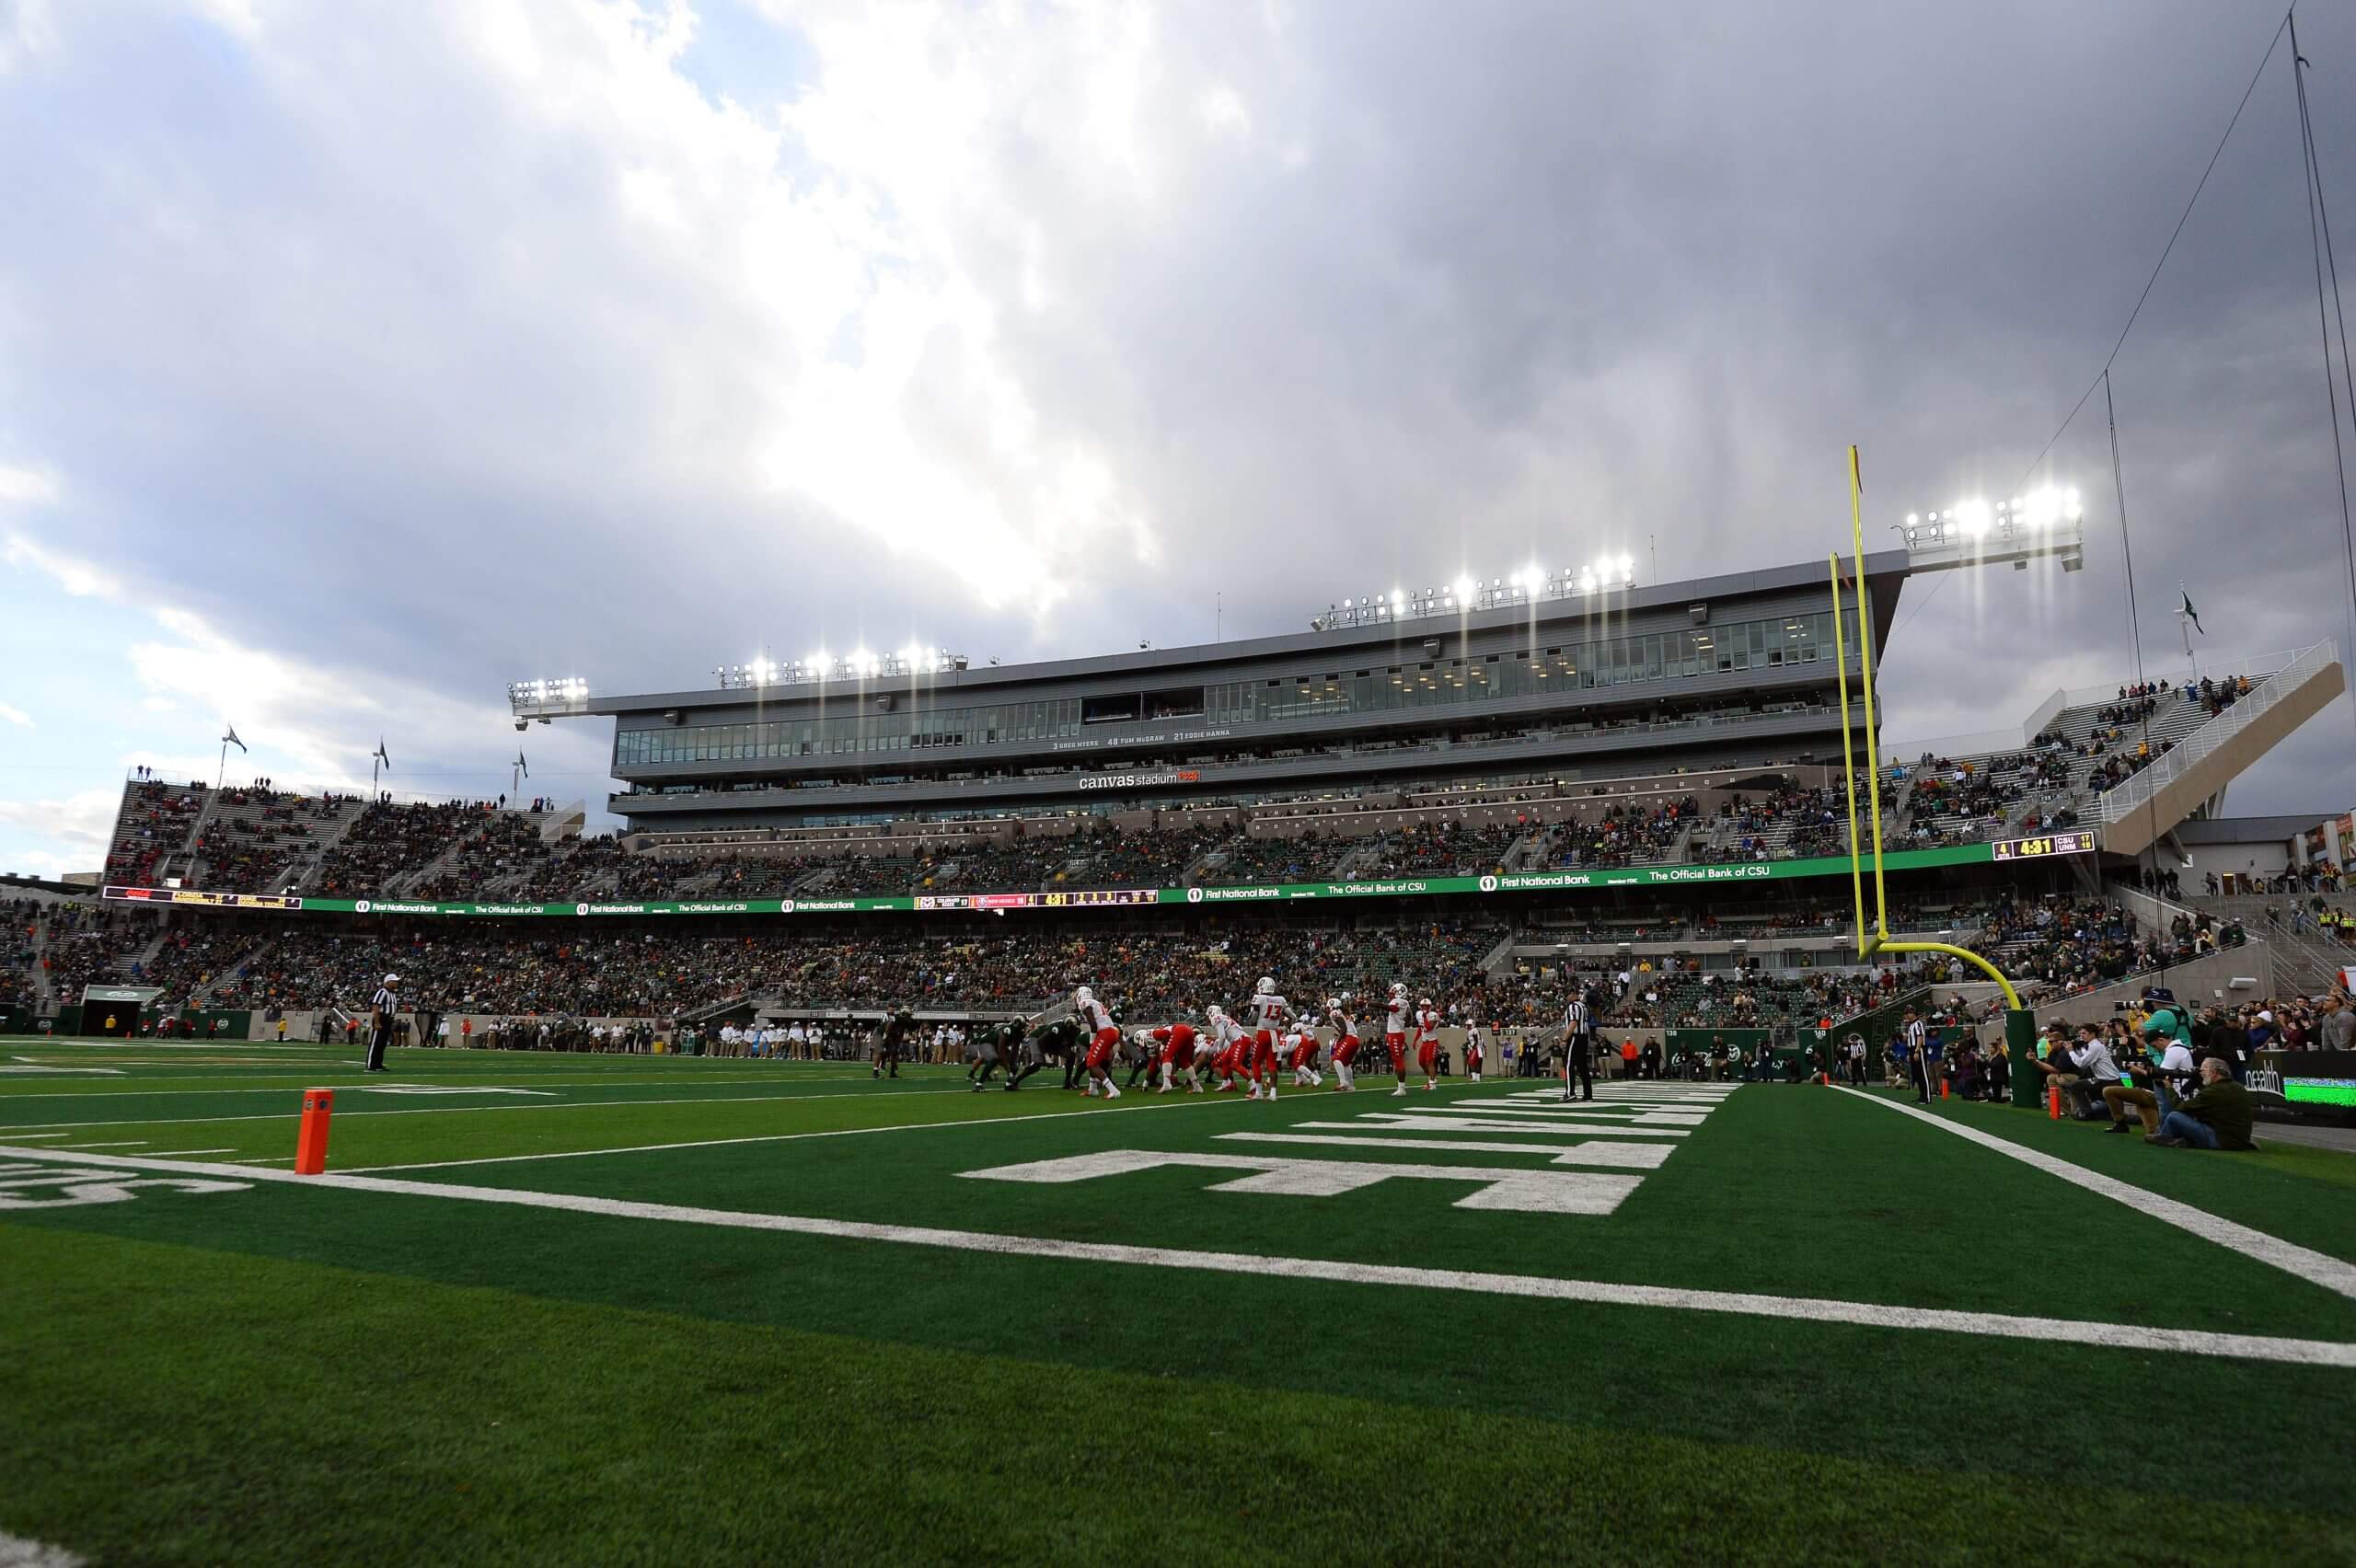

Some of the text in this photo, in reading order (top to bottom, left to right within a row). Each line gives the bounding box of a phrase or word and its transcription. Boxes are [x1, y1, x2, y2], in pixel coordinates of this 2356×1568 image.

[1120, 737, 1135, 745] FUM
[1173, 729, 1230, 741] 21 EDDIE HANNA
[1053, 739, 1100, 751] 3 GREG MYERS
[1079, 775, 1135, 790] canvas
[1137, 772, 1177, 786] stadium
[2000, 843, 2006, 853] 4
[2020, 838, 2051, 855] 4:31
[2058, 843, 2076, 851] UNM
[1648, 865, 1770, 881] The Official Bank of CSU
[1501, 876, 1520, 888] First
[1520, 874, 1564, 887] National
[1564, 873, 1590, 886] Bank
[1206, 890, 1222, 900] First
[1222, 888, 1258, 899] National
[1257, 887, 1280, 898] Bank
[1328, 882, 1426, 895] The Official Bank of CSU
[795, 902, 810, 911] First
[809, 901, 838, 910] National
[837, 900, 856, 909] Bank
[1045, 894, 1068, 906] 4:31
[372, 902, 387, 912] First
[387, 904, 419, 913] National
[419, 905, 438, 913] Bank
[475, 905, 488, 914] The
[487, 905, 511, 915] Official
[510, 906, 525, 915] Bank
[524, 906, 531, 915] of
[531, 906, 544, 915] CSU
[602, 905, 628, 913] National
[628, 905, 644, 913] Bank
[1264, 1004, 1282, 1020] 13
[1492, 1020, 1500, 1031] 2
